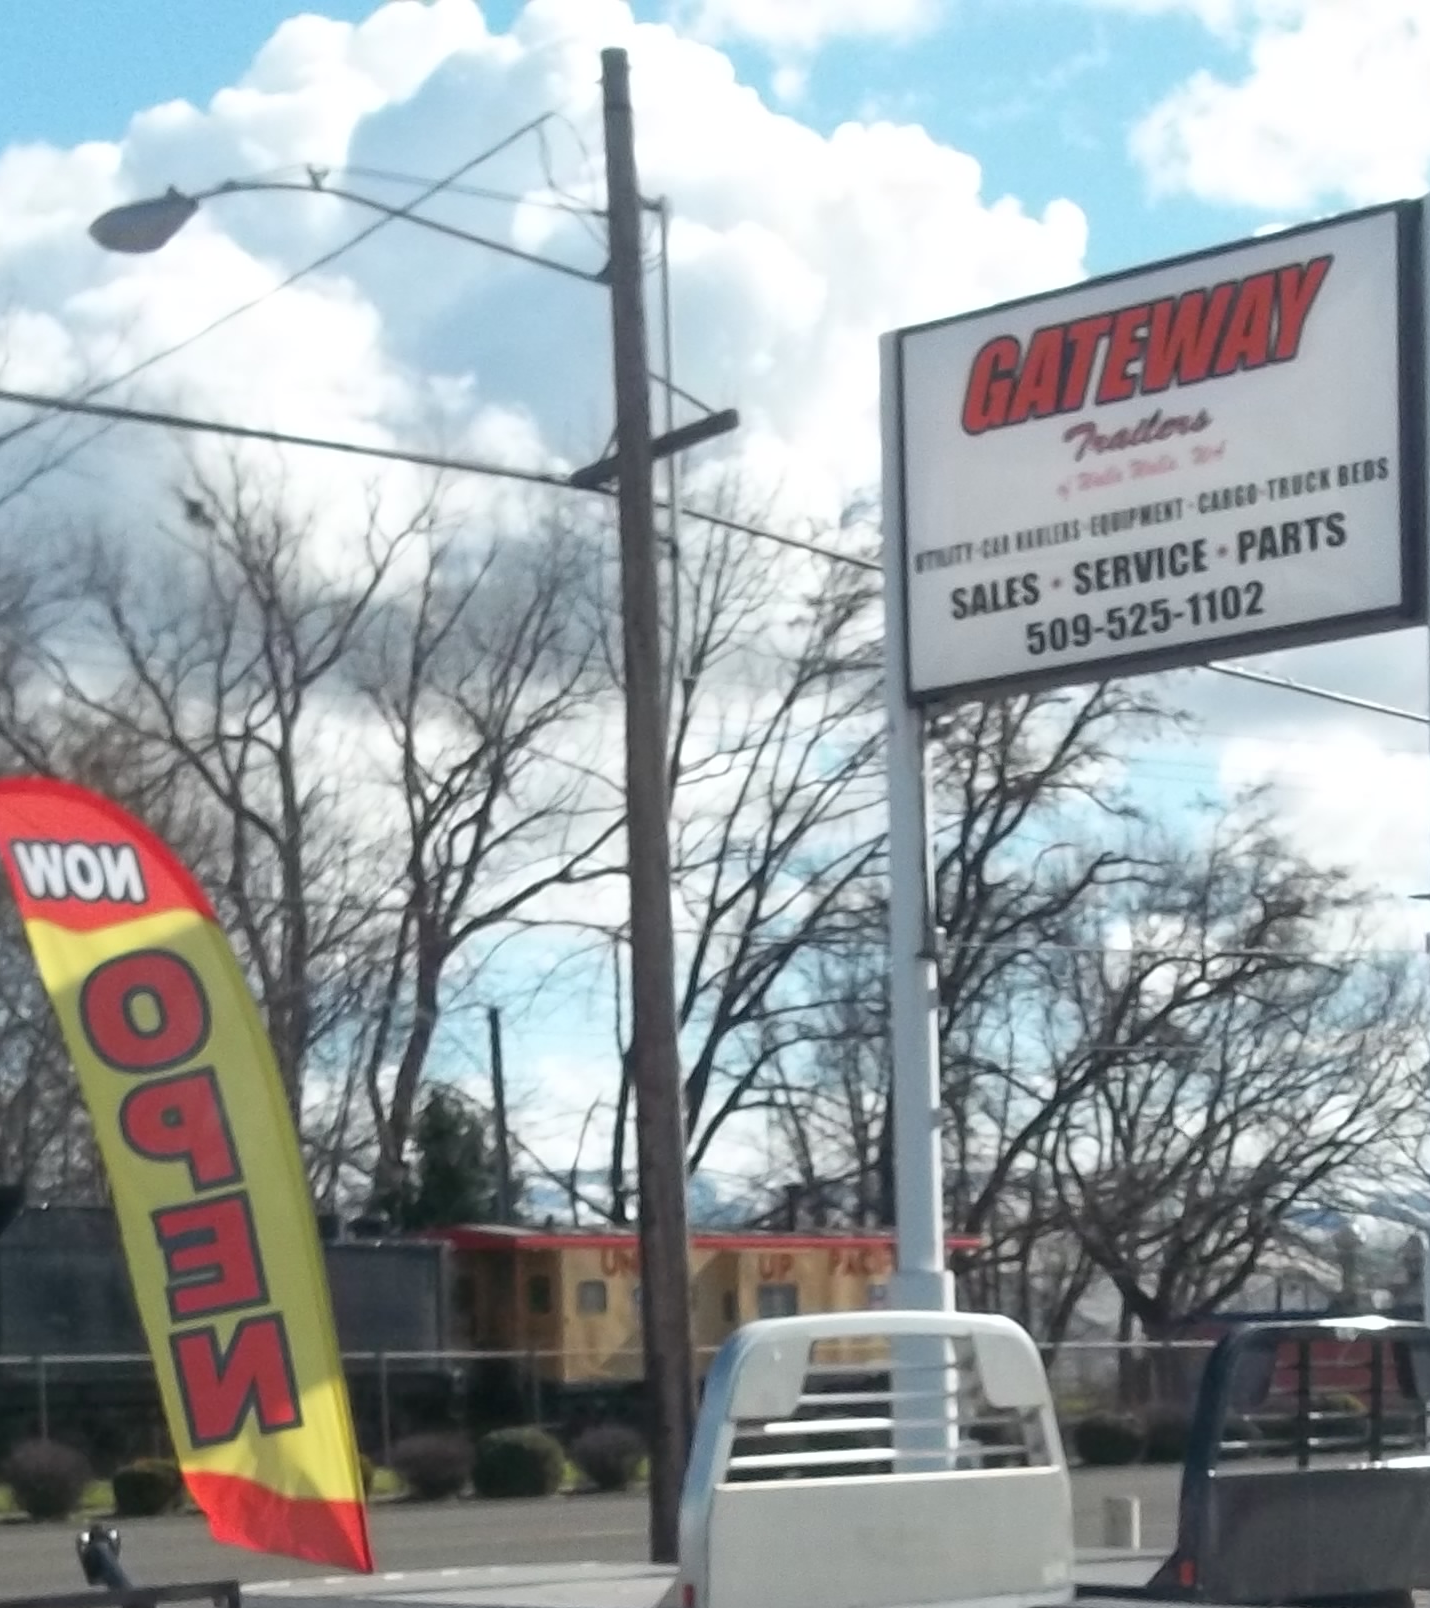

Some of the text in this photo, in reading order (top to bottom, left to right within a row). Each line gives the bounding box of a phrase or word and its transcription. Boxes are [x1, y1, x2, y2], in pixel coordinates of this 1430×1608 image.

[961, 253, 1335, 436] GATEWAY
[1062, 407, 1214, 462] Trailers
[1197, 483, 1259, 515] CARGO
[1267, 467, 1331, 502] TRUCK
[1337, 456, 1389, 488] BEDS
[951, 511, 1347, 620] SALES SERVICE PARTS
[1025, 579, 1265, 655] 509-525-1102
